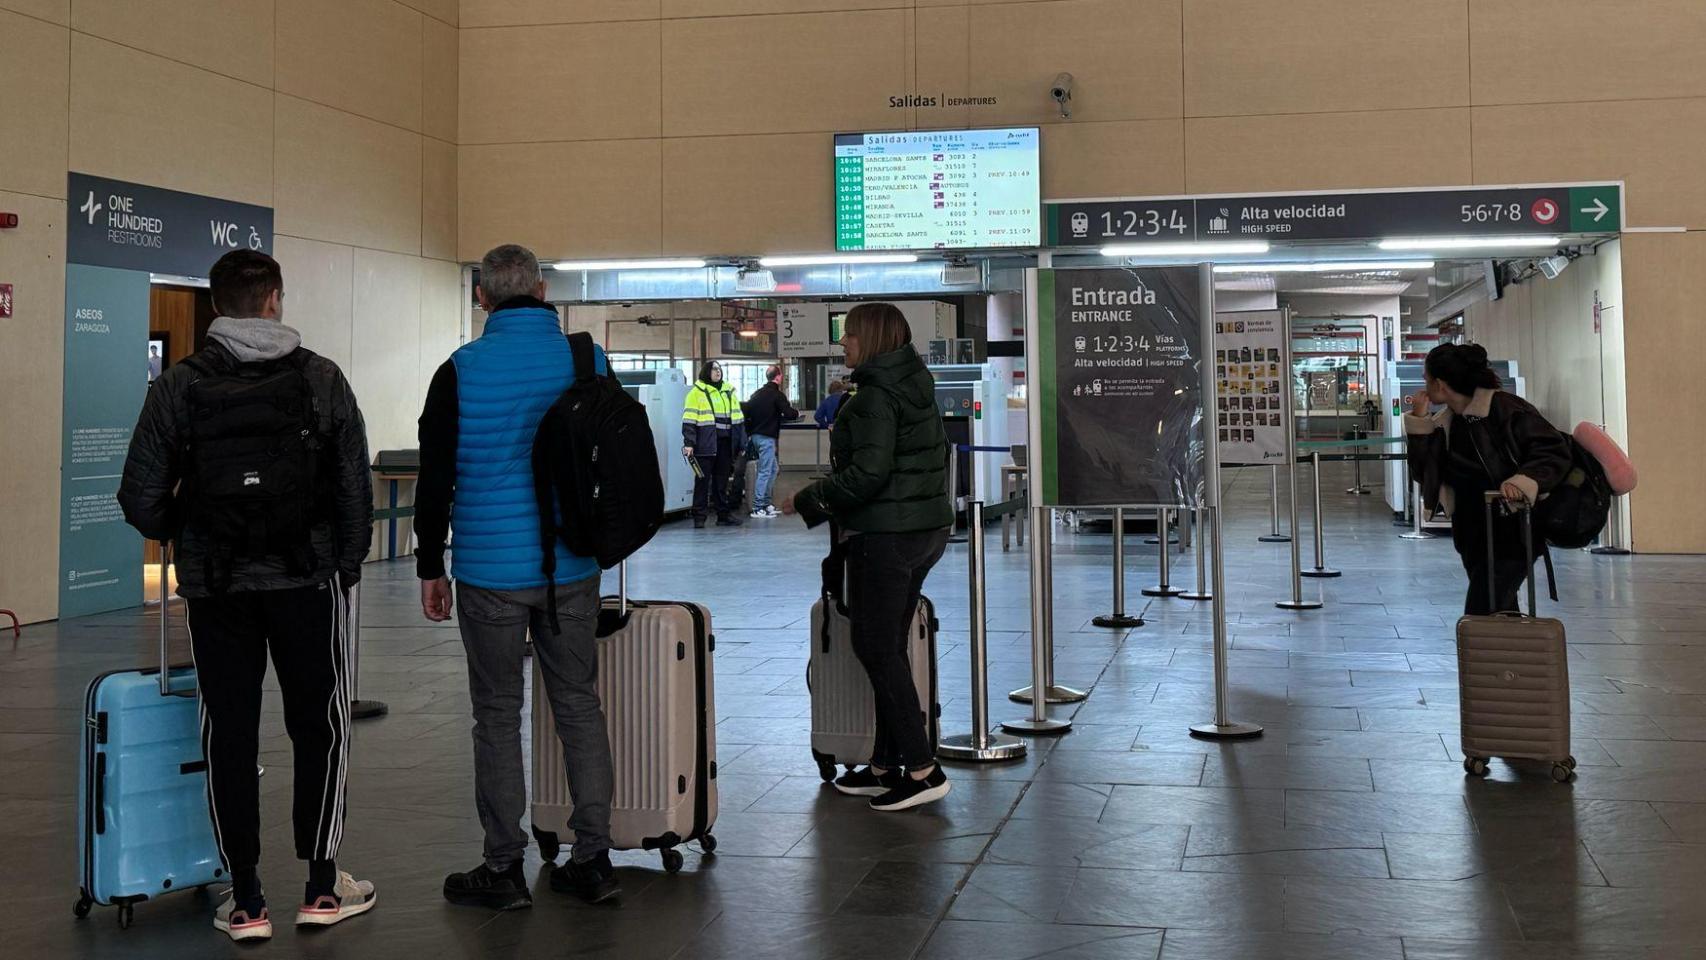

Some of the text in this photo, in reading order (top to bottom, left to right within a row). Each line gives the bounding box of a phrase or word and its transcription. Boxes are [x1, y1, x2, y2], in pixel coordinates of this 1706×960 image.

[889, 95, 997, 108] Salidas DEPARTURES
[868, 134, 964, 145] Salidas DEPARTURES
[109, 195, 133, 213] ONE
[1240, 203, 1346, 220] Alta velocidad
[109, 212, 163, 234] HUNDRED
[1241, 223, 1292, 234] HIGH SPEED
[107, 229, 162, 249] RESTROOMS
[210, 219, 238, 248] WC
[1072, 286, 1157, 306] Entrada
[75, 309, 102, 320] ASEOS
[1071, 310, 1132, 323] ENTRANCE
[75, 323, 110, 334] ZARAGOZA
[783, 319, 794, 339] 3
[1155, 335, 1174, 344] Vías
[1074, 358, 1143, 368] Alta velocidad
